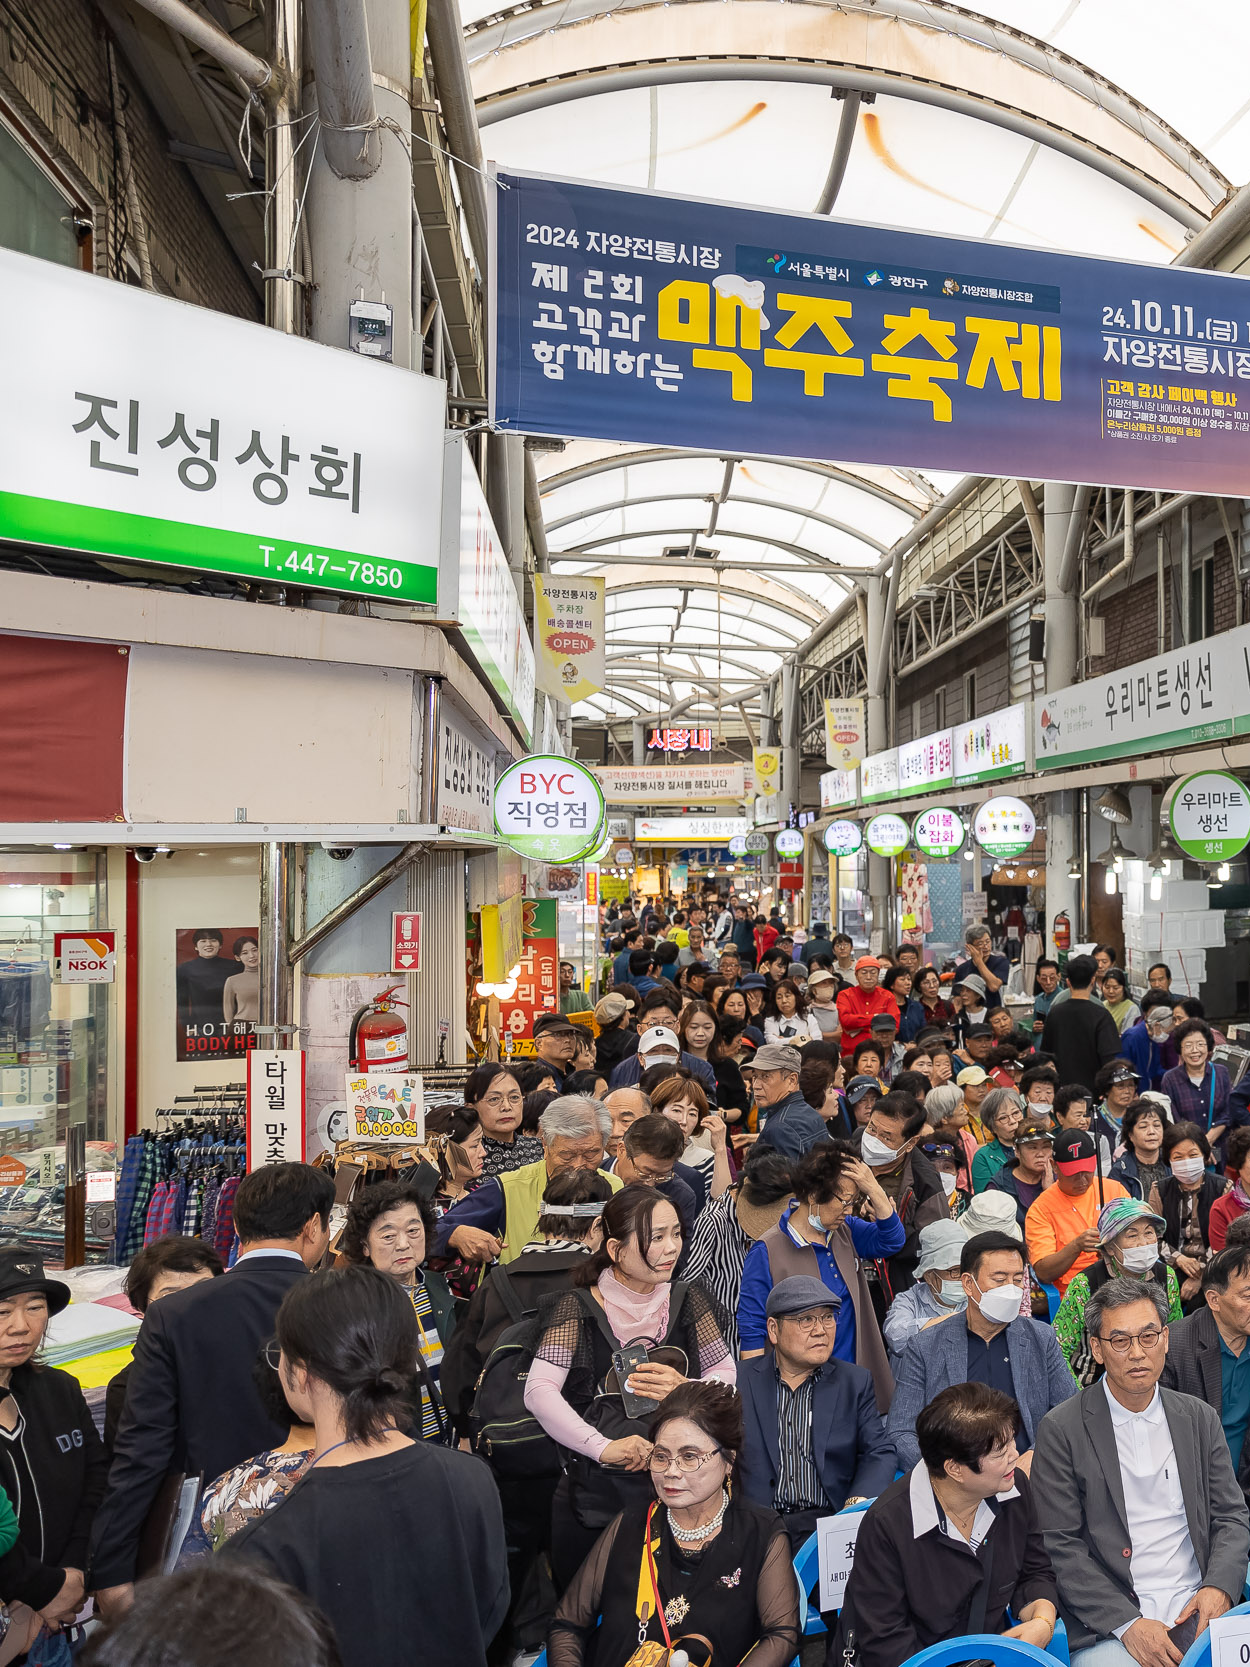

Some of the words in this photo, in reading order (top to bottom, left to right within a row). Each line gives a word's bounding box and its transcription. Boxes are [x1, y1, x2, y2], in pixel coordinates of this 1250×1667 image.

[526, 223, 580, 249] 2024
[586, 230, 722, 270] 자양전통시장
[531, 261, 568, 294] 제
[787, 261, 850, 282] 서울특별시
[888, 274, 929, 289] 광진구
[961, 284, 1034, 304] 자양전통시장조합
[531, 301, 645, 346] 고객과
[531, 340, 684, 393] 함께하는
[1107, 379, 1134, 396] 고객
[1138, 383, 1165, 399] 감사
[1168, 386, 1208, 404] 페이백
[1210, 390, 1238, 407] 행사
[1107, 398, 1155, 411] 자양전통시장
[1157, 403, 1181, 414] 내에서
[1182, 405, 1210, 417] 24.10.10
[1234, 411, 1249, 420] 10.11
[1107, 408, 1131, 420] 이틀간
[1133, 411, 1158, 424] 구매한
[1159, 414, 1191, 427] 30,000원
[1192, 417, 1208, 429] 이상
[1210, 419, 1232, 431] 영수증
[1234, 421, 1250, 432] 지참
[1107, 419, 1155, 433] 온누리상품권
[1156, 425, 1184, 436] 5,000원
[1185, 427, 1202, 438] 증정
[71, 391, 362, 514] 진성상회
[258, 544, 404, 589] T.447-7850
[542, 588, 597, 600] 자양전통시장
[556, 604, 584, 614] 주차장
[547, 618, 593, 630] 배송콜센터
[553, 638, 589, 650] OPEN
[1104, 651, 1214, 733] 우리마트생선
[835, 734, 857, 742] OPEN
[520, 773, 575, 795] BYC
[614, 780, 665, 791] 자양전통시장
[667, 780, 692, 790] 질서를
[694, 779, 728, 789] 해칩니다
[1179, 792, 1243, 811] 우리마트
[507, 801, 587, 829] 직영점
[928, 814, 953, 828] 이불
[1197, 814, 1229, 833] 생선
[918, 825, 927, 835] &
[929, 830, 954, 844] 잡화
[532, 838, 560, 852] 속옷
[1204, 842, 1223, 854] 생선
[396, 941, 418, 949] 소화기
[68, 960, 108, 971] NSOK
[186, 1037, 230, 1051] BODY
[265, 1061, 287, 1110] 타월
[378, 1084, 412, 1104] SALE
[354, 1105, 394, 1122] 균일가
[356, 1120, 418, 1138] 10,000원
[1068, 1141, 1082, 1158] T
[43, 1153, 51, 1179] 당기시오
[56, 1429, 83, 1453] DG
